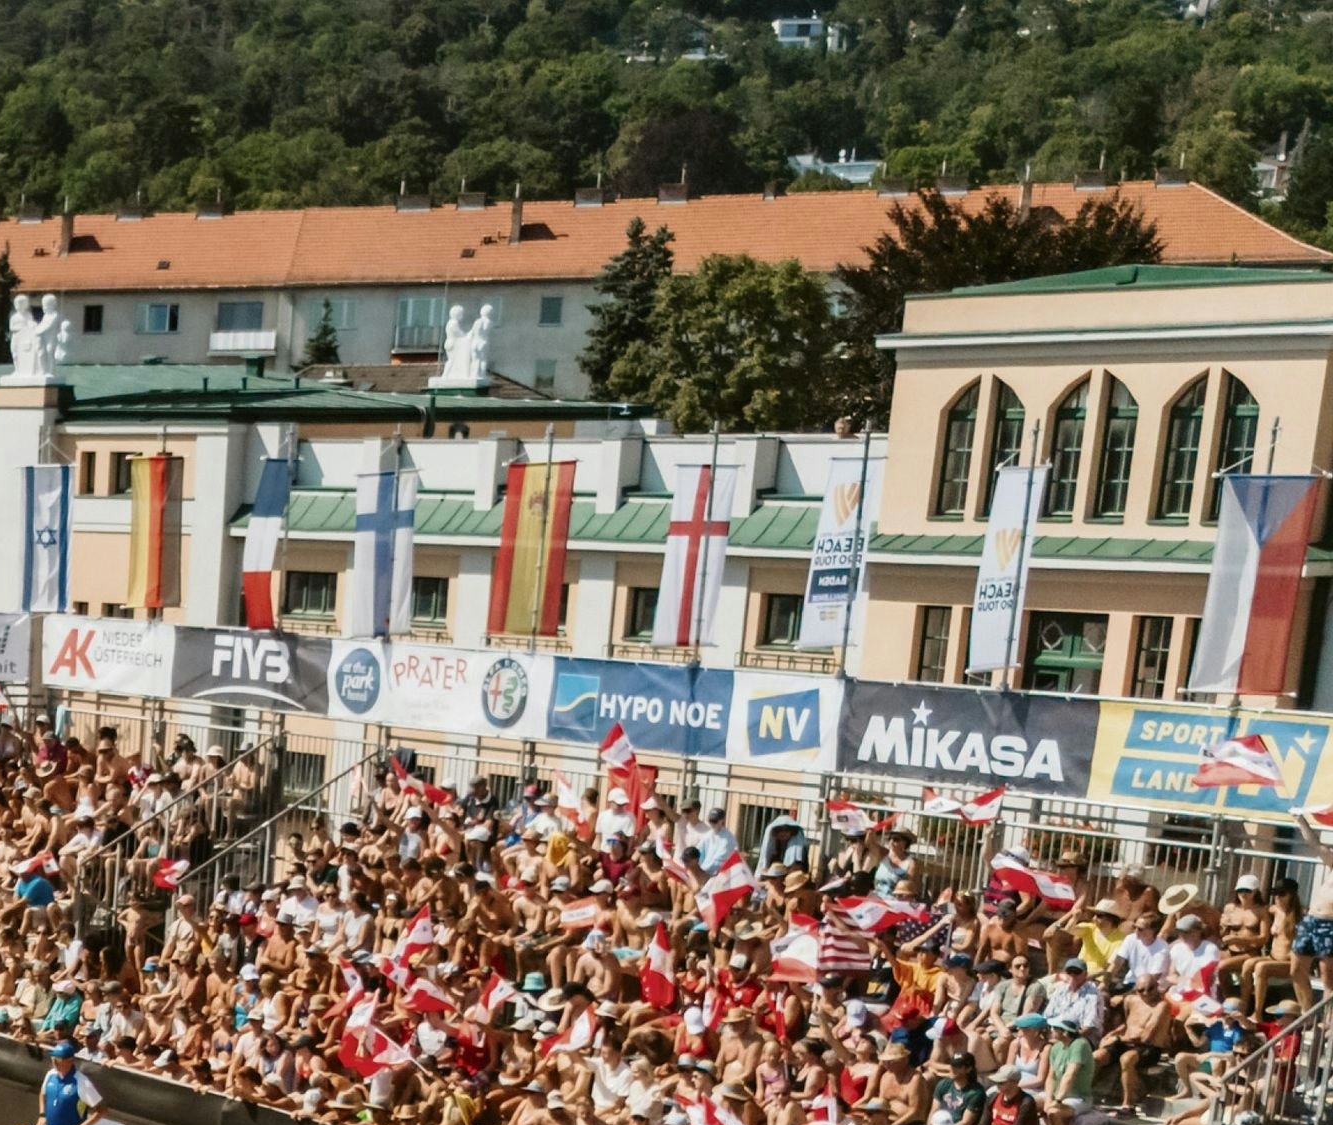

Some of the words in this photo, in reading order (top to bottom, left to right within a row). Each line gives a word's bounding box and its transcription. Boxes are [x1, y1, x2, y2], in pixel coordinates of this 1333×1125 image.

[49, 628, 96, 679] AK
[211, 634, 291, 684] FIVB
[393, 655, 468, 690] PRATER
[340, 665, 375, 697] park
[599, 692, 665, 723] HYPO
[669, 699, 723, 730] NOE
[758, 704, 811, 742] NV
[857, 702, 1065, 782] MIKASA
[1140, 719, 1226, 747] SPORT
